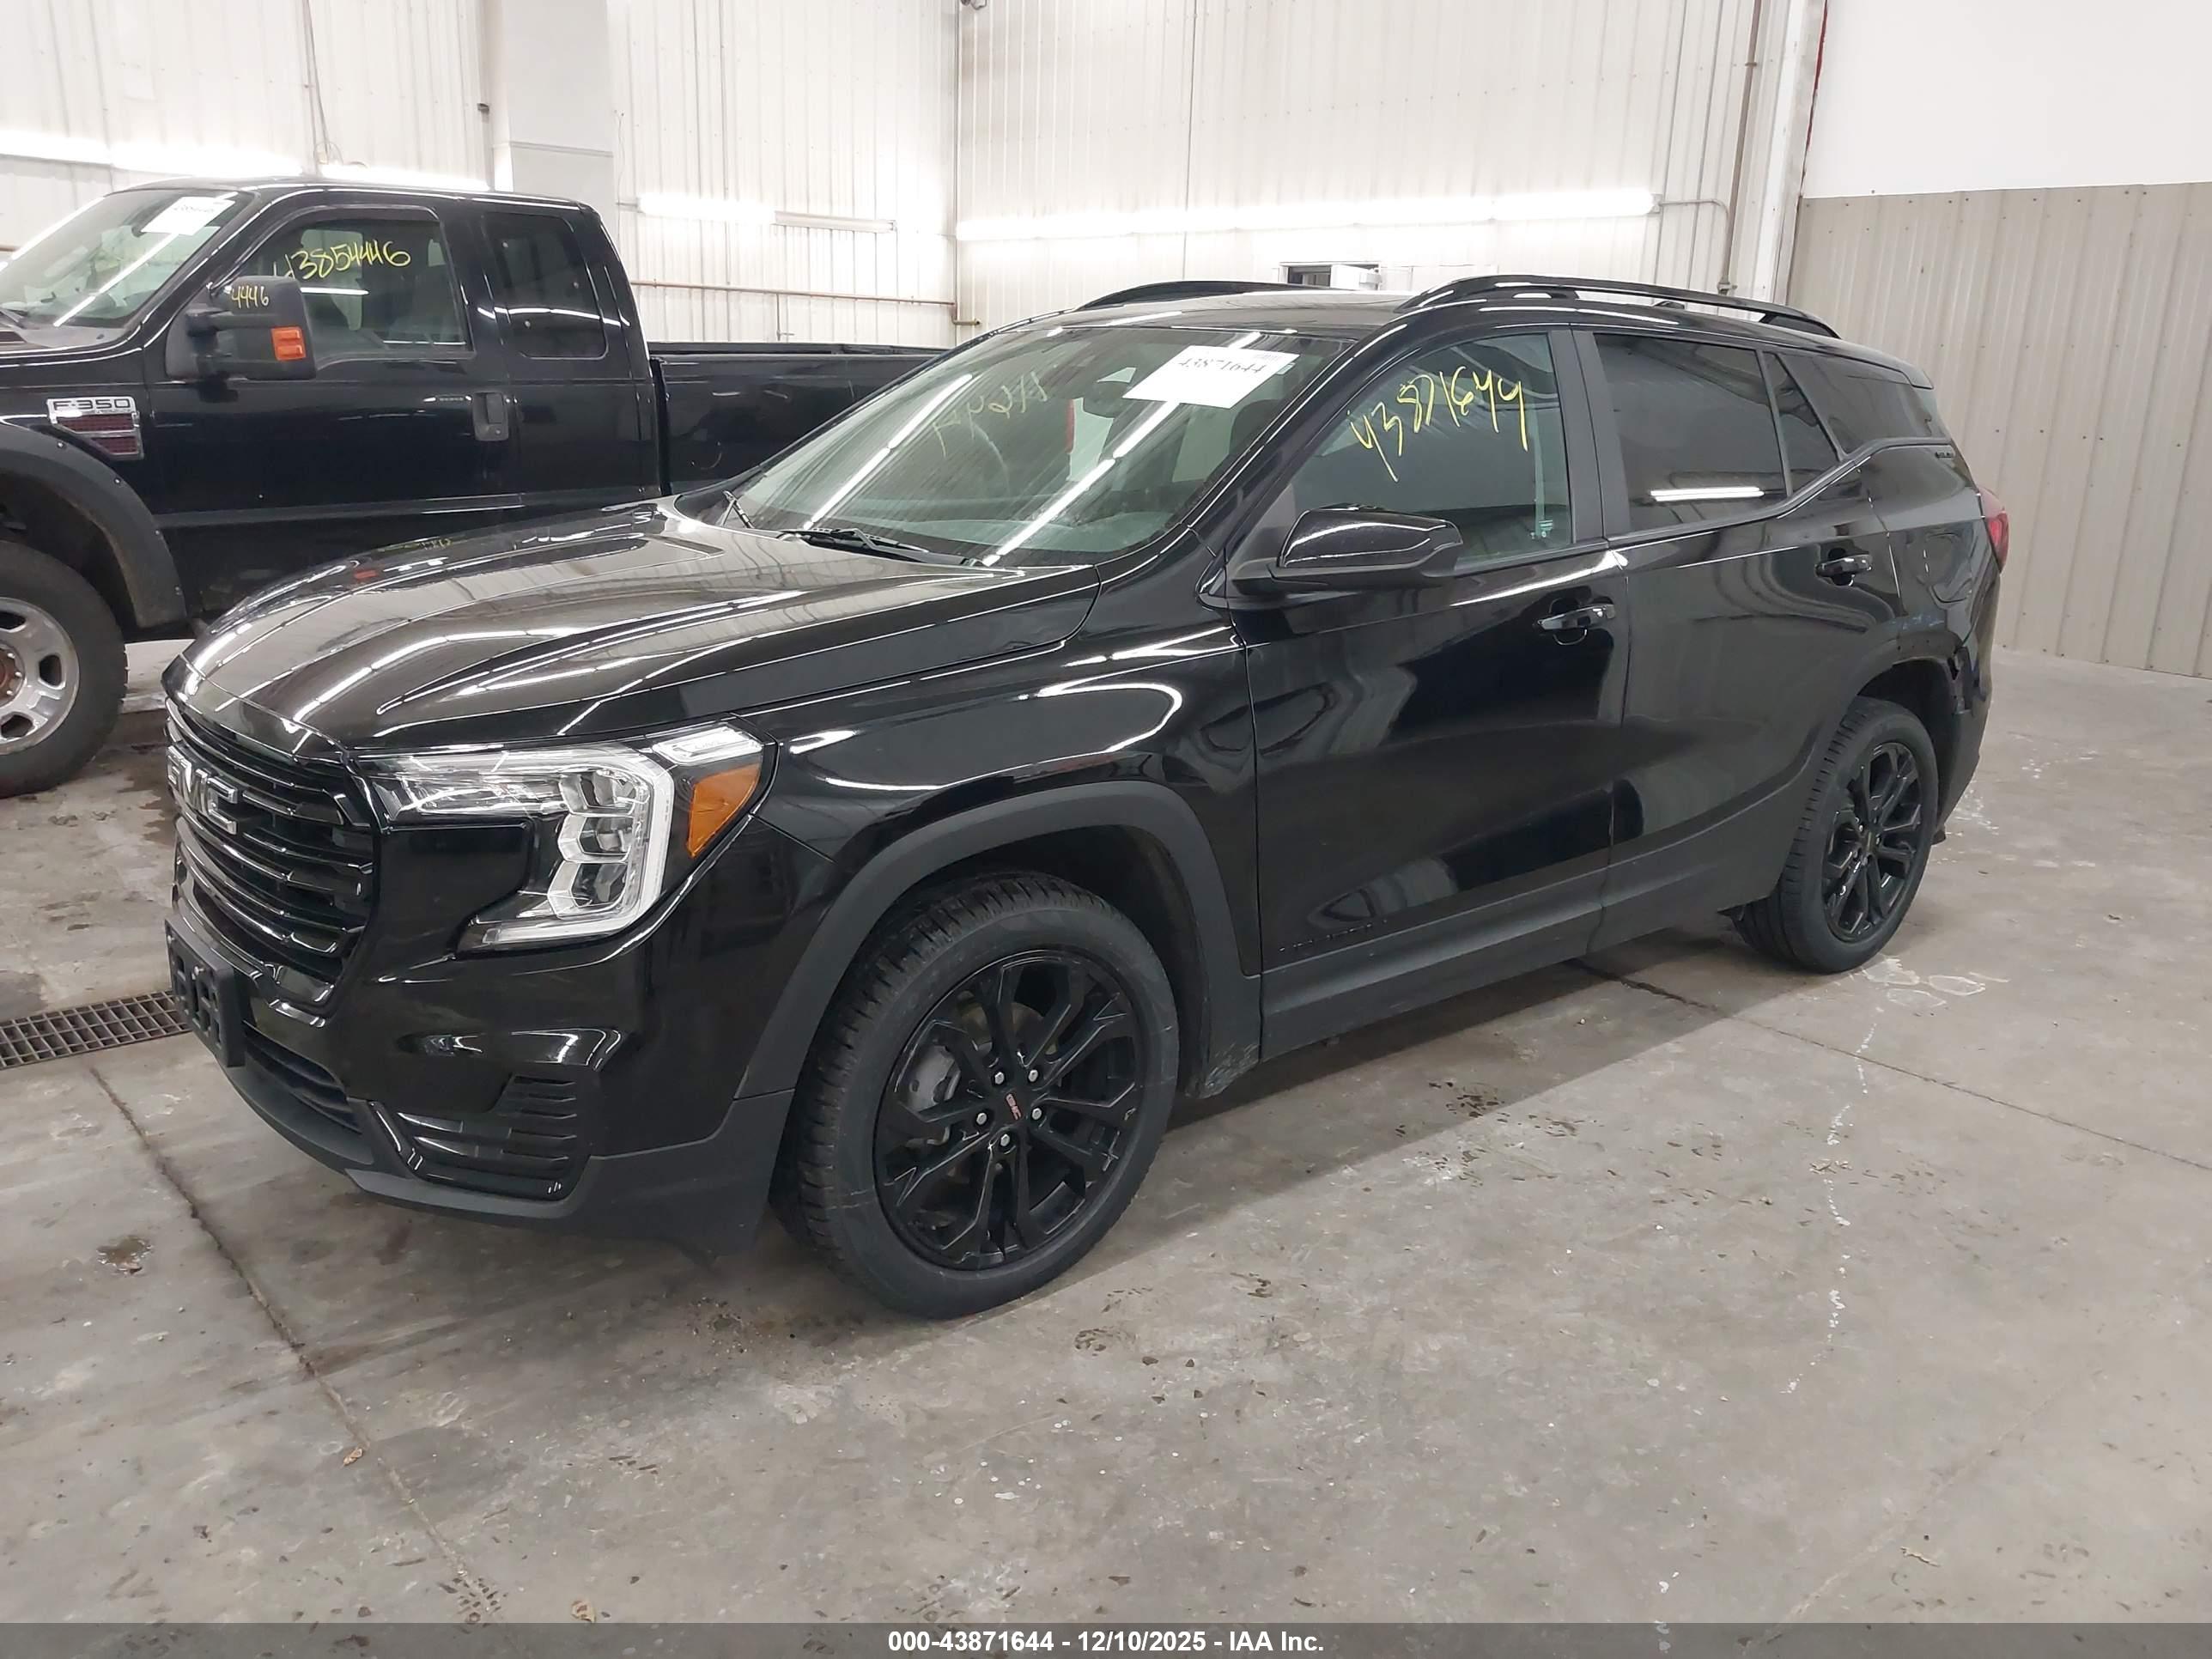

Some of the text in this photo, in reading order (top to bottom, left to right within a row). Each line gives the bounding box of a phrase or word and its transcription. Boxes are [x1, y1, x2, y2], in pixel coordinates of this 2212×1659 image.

[231, 285, 270, 309] 4446
[52, 398, 131, 411] F-350
[1348, 366, 1528, 482] 43871644
